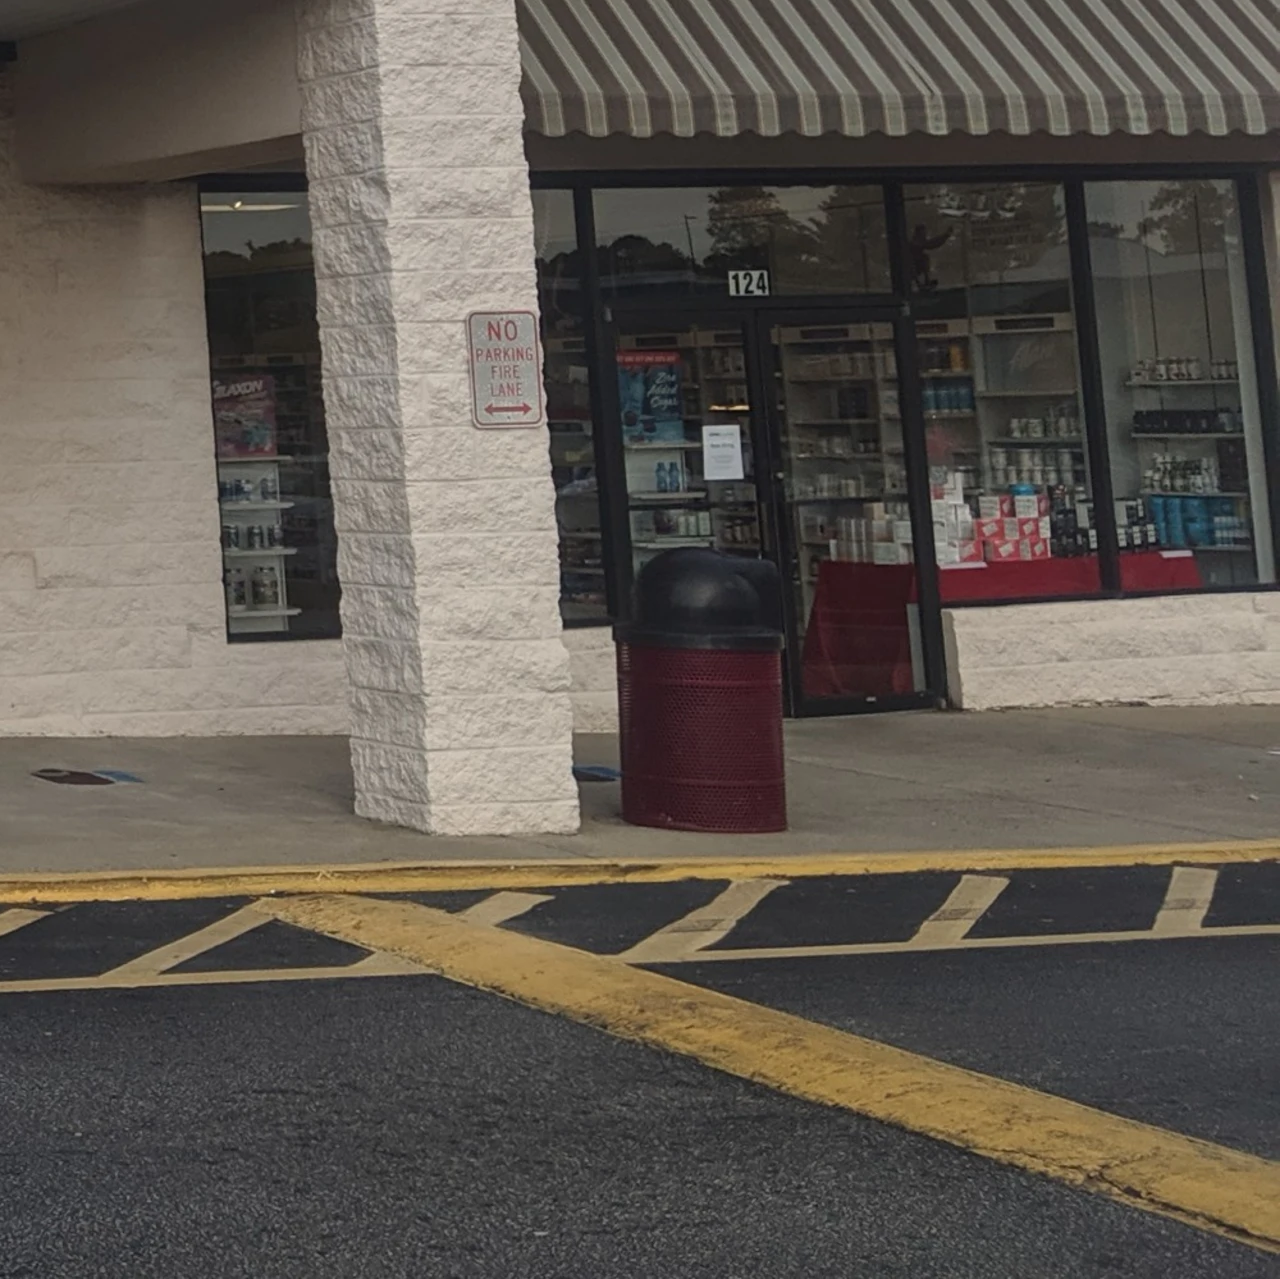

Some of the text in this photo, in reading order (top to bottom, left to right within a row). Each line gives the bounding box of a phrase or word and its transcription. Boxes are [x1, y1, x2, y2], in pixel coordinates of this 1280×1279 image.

[731, 272, 767, 295] 124
[487, 320, 518, 341] NO
[475, 347, 534, 362] PARKING
[491, 365, 521, 380] FIRE
[491, 382, 524, 398] LANE
